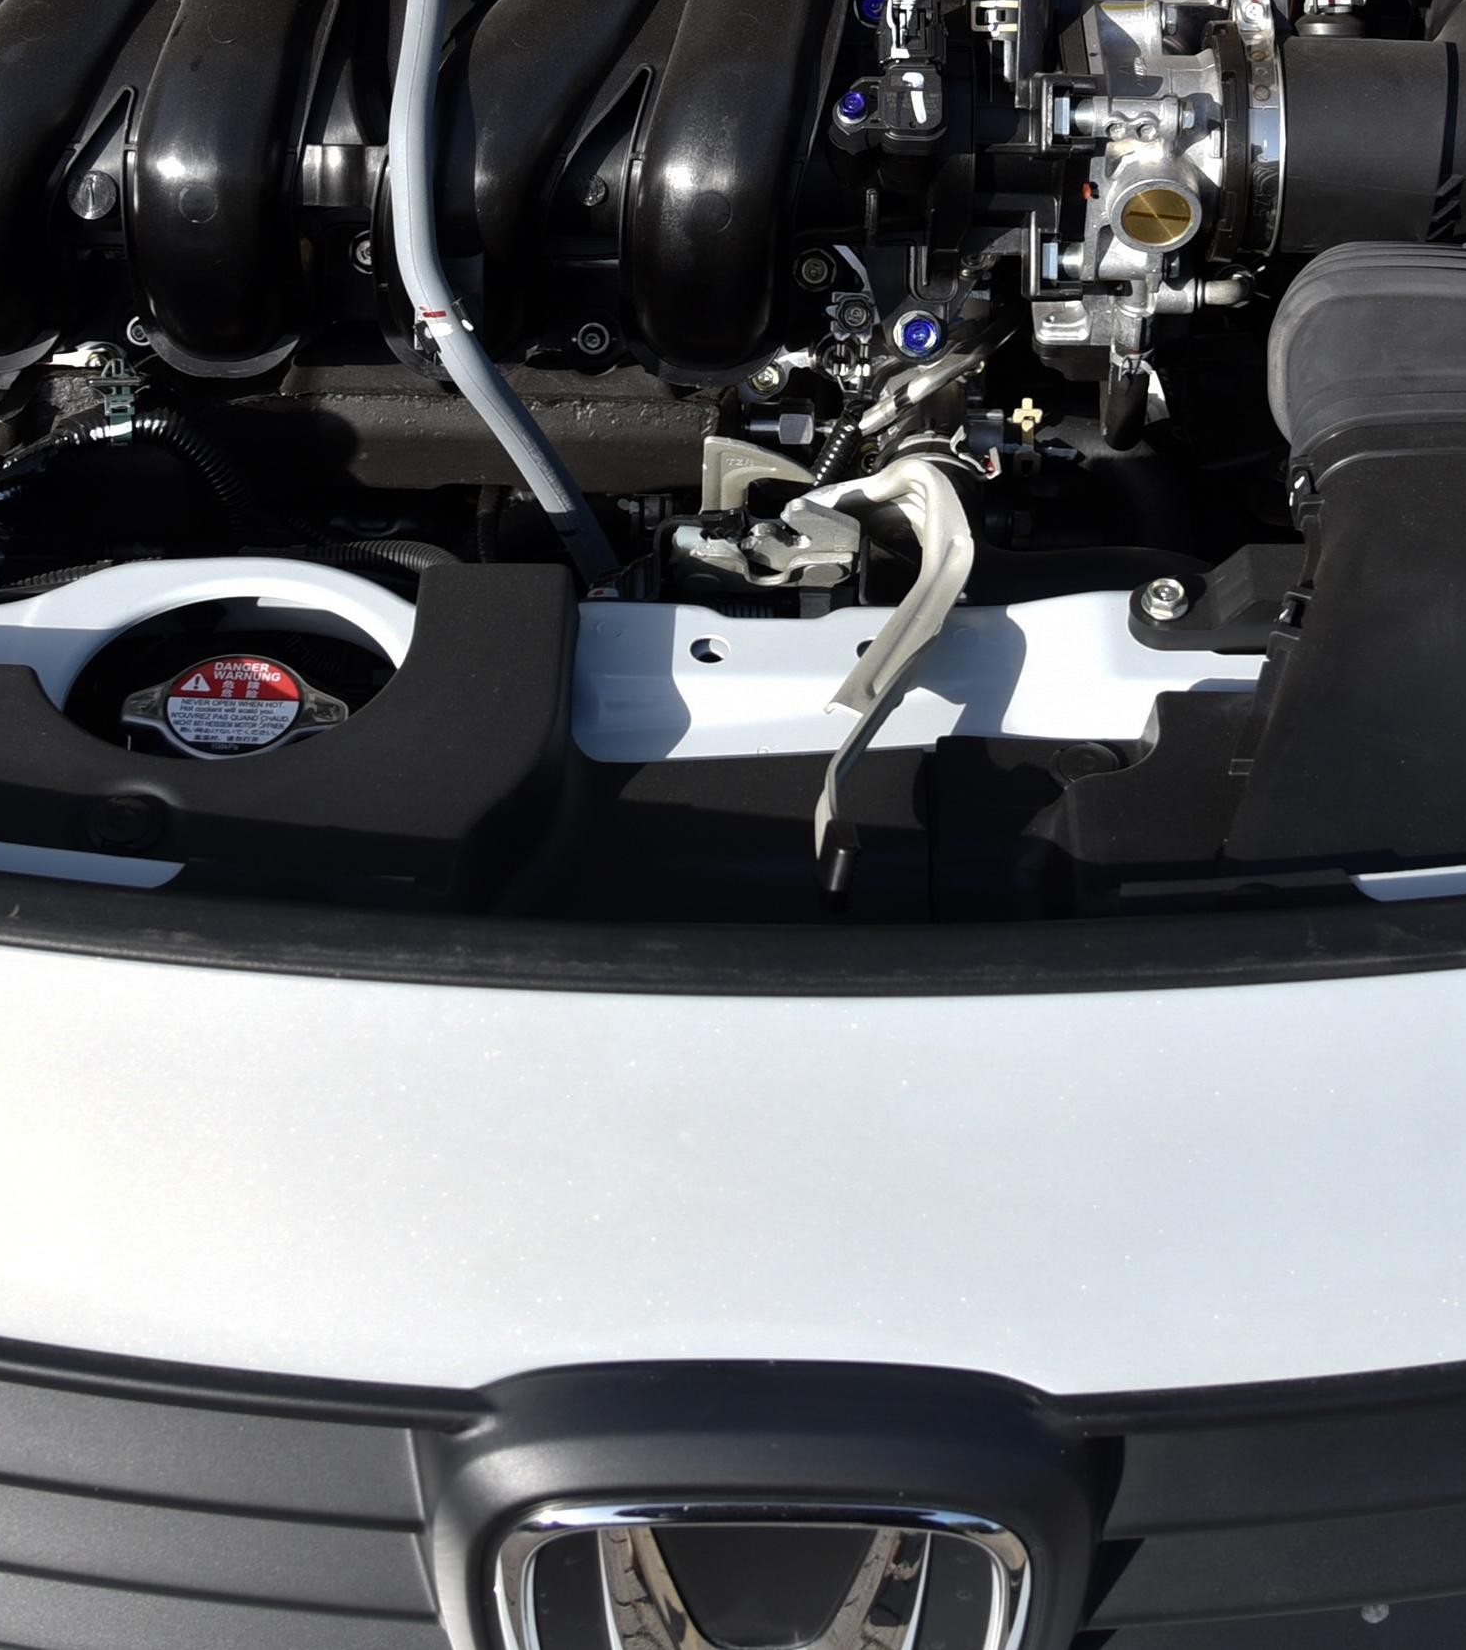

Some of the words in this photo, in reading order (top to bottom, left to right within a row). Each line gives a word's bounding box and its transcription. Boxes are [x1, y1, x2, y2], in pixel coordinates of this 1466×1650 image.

[214, 662, 270, 672] DANGER
[213, 671, 282, 682] WARNUNG
[181, 698, 211, 706] NEVER
[212, 699, 237, 707] OPEN
[238, 700, 265, 708] WHEN
[230, 714, 259, 722] QUAND
